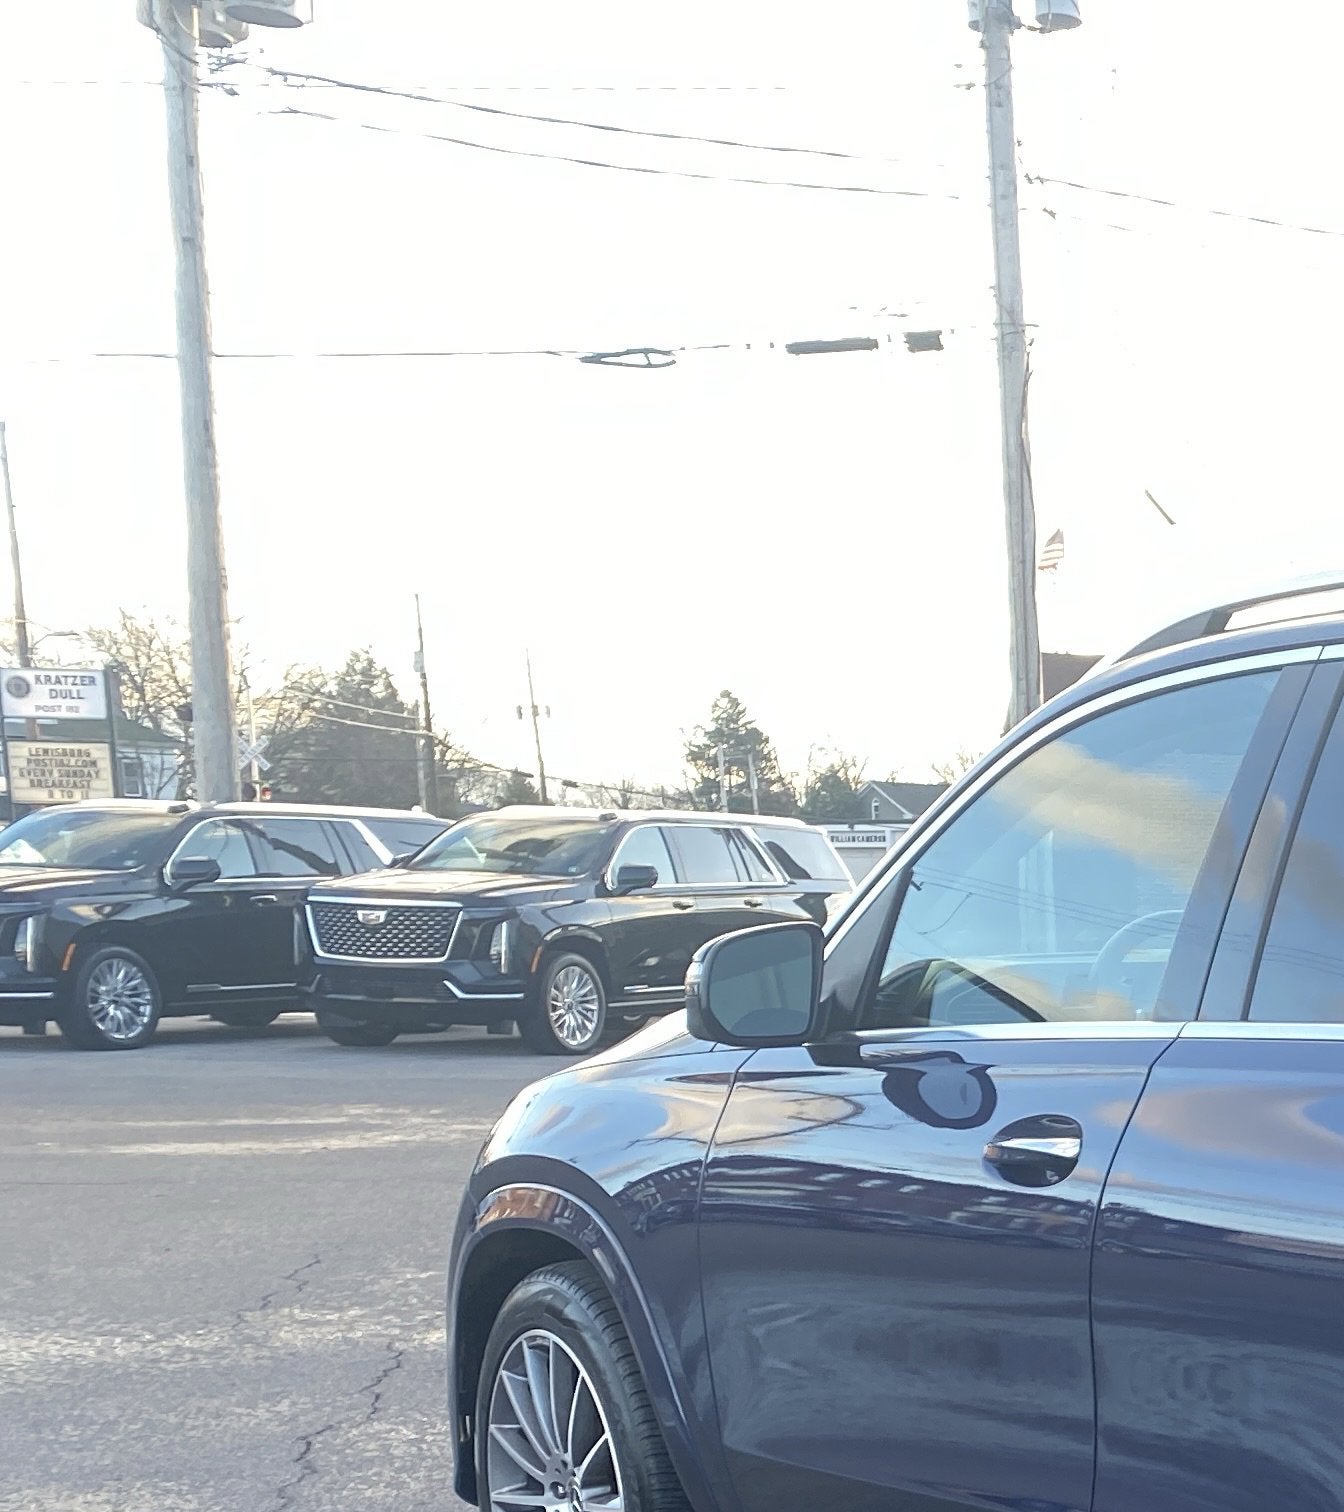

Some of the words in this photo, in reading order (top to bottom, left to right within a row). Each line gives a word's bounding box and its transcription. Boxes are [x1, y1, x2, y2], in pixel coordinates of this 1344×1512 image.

[34, 674, 97, 686] KRATZER
[49, 689, 86, 700] DULL
[34, 704, 63, 713] POST
[28, 747, 91, 758] LEWISBURG
[18, 768, 54, 778] EVERY
[57, 768, 100, 779] SUNDAY
[29, 779, 92, 789] BREAKFAST
[59, 790, 74, 799] TO
